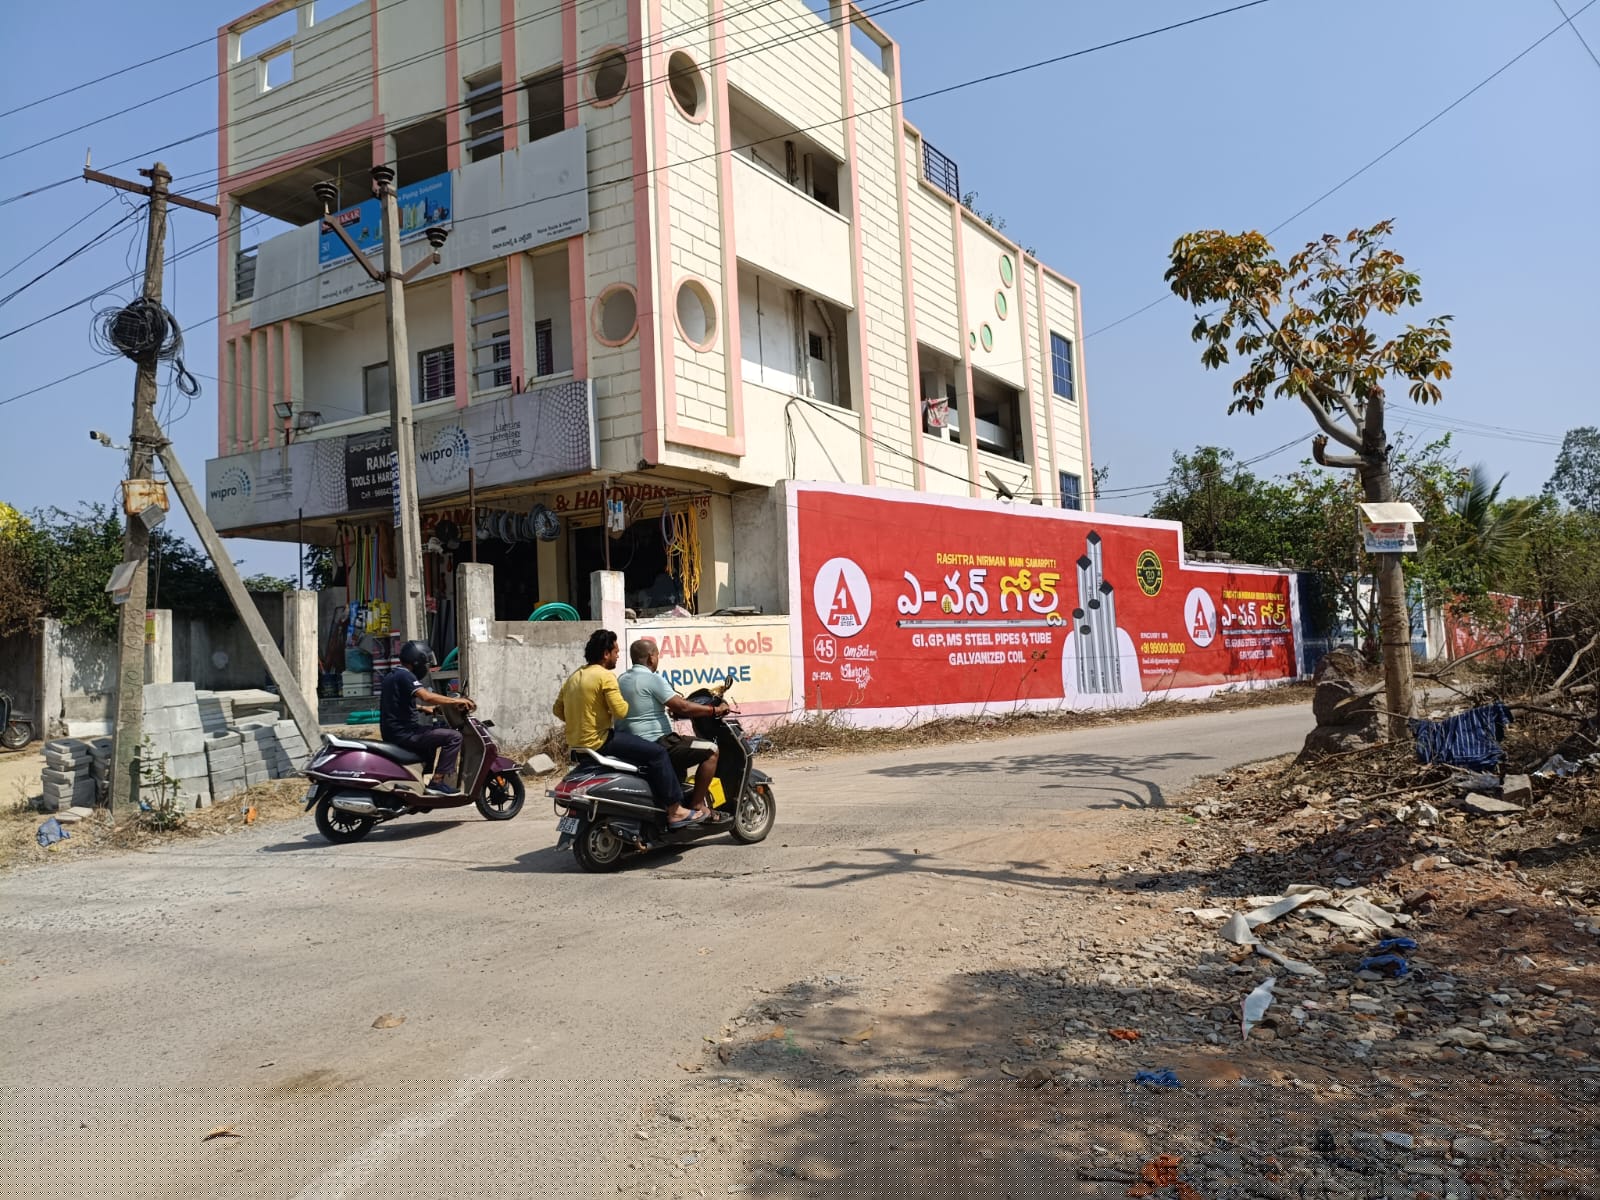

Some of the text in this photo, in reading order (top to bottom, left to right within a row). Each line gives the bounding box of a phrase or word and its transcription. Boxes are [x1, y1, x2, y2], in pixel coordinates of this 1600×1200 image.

[366, 454, 392, 471] RANA
[420, 447, 453, 465] wipro
[350, 475, 371, 488] TOOLS
[371, 474, 377, 484] &
[210, 487, 237, 502] wipro
[936, 552, 975, 566] RASHTRA
[976, 554, 1006, 567] NIRMAN
[722, 631, 773, 655] tools
[964, 632, 994, 646] STEEL
[994, 632, 1020, 645] PIPES
[1021, 633, 1028, 648] &
[1029, 631, 1052, 645] TUBE
[816, 639, 833, 658] 45
[948, 650, 1026, 666] GALVANIZED COIL
[656, 665, 752, 687] ARDWARE
